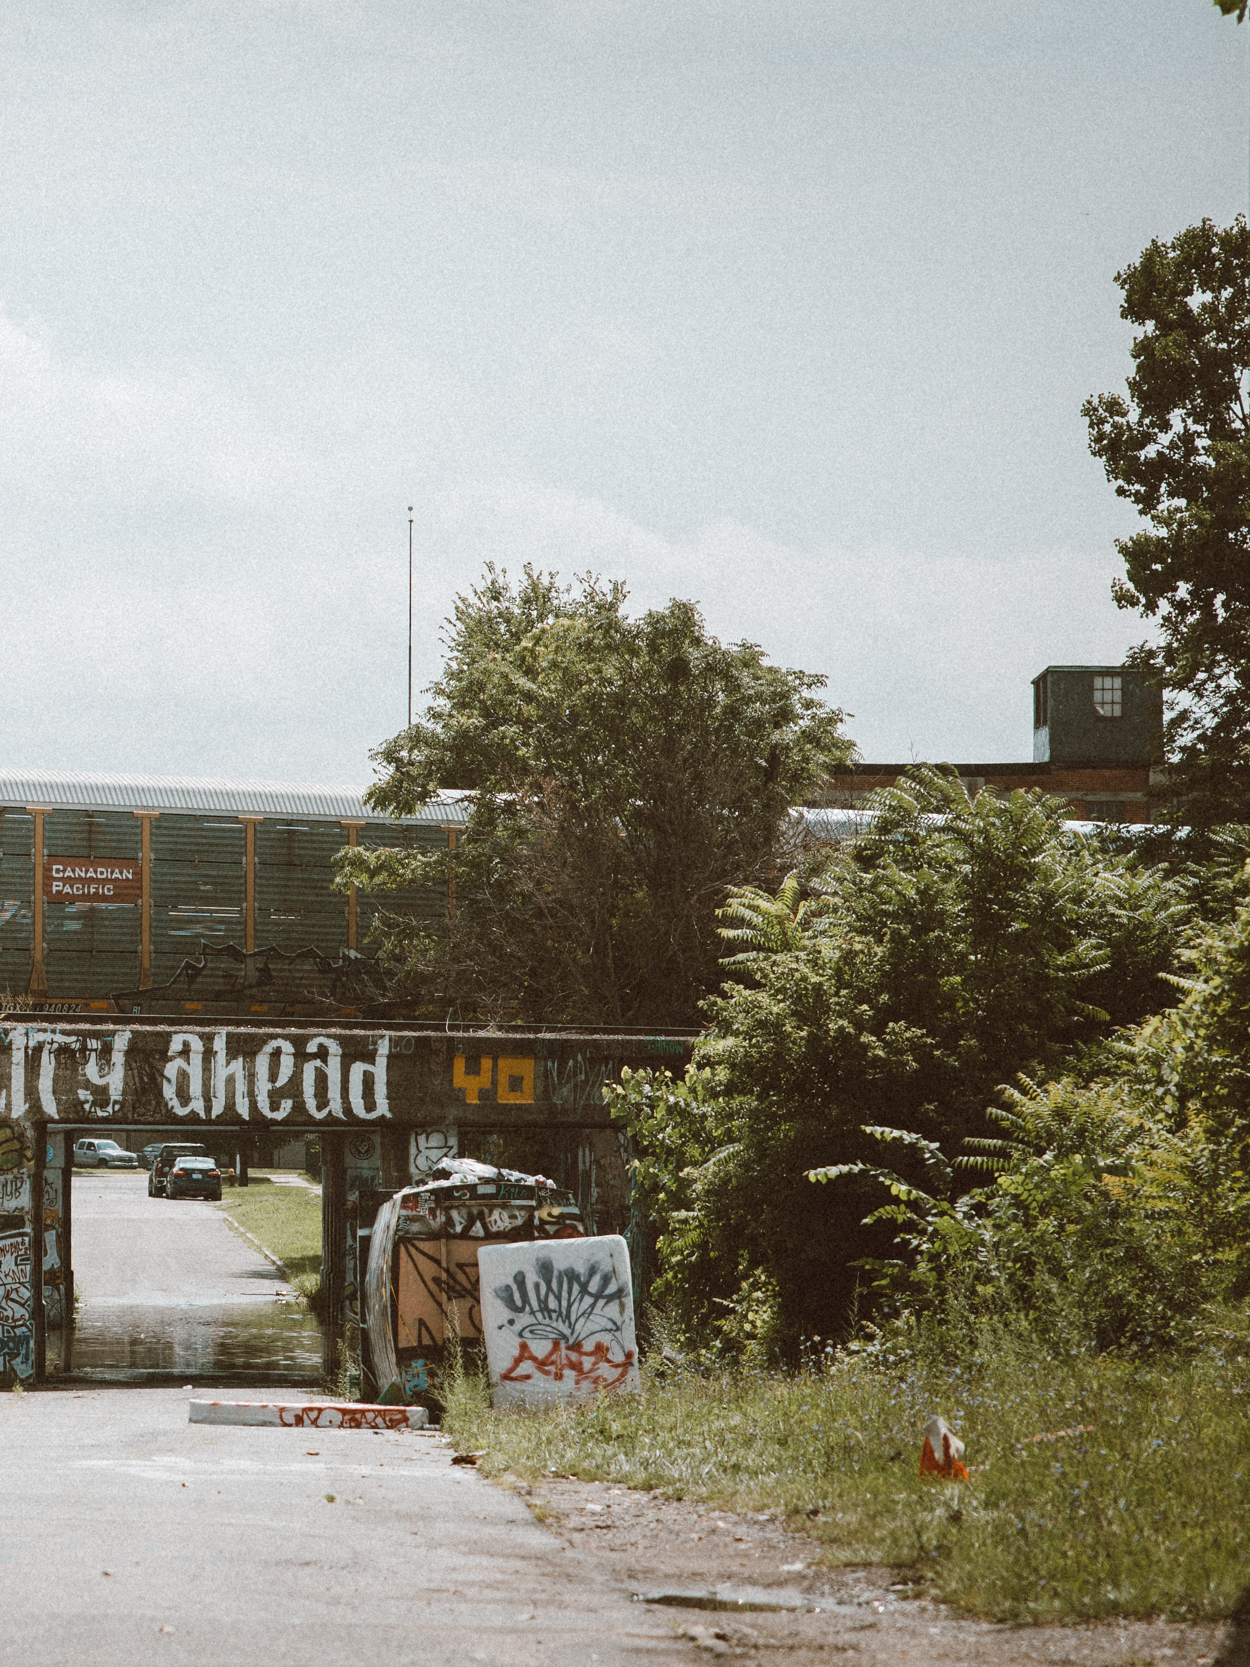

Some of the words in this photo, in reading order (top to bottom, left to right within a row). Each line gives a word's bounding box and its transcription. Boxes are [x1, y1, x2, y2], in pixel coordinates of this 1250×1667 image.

[52, 865, 133, 880] CANADIAN
[52, 881, 114, 895] PACIFIC
[453, 1053, 535, 1104] YO
